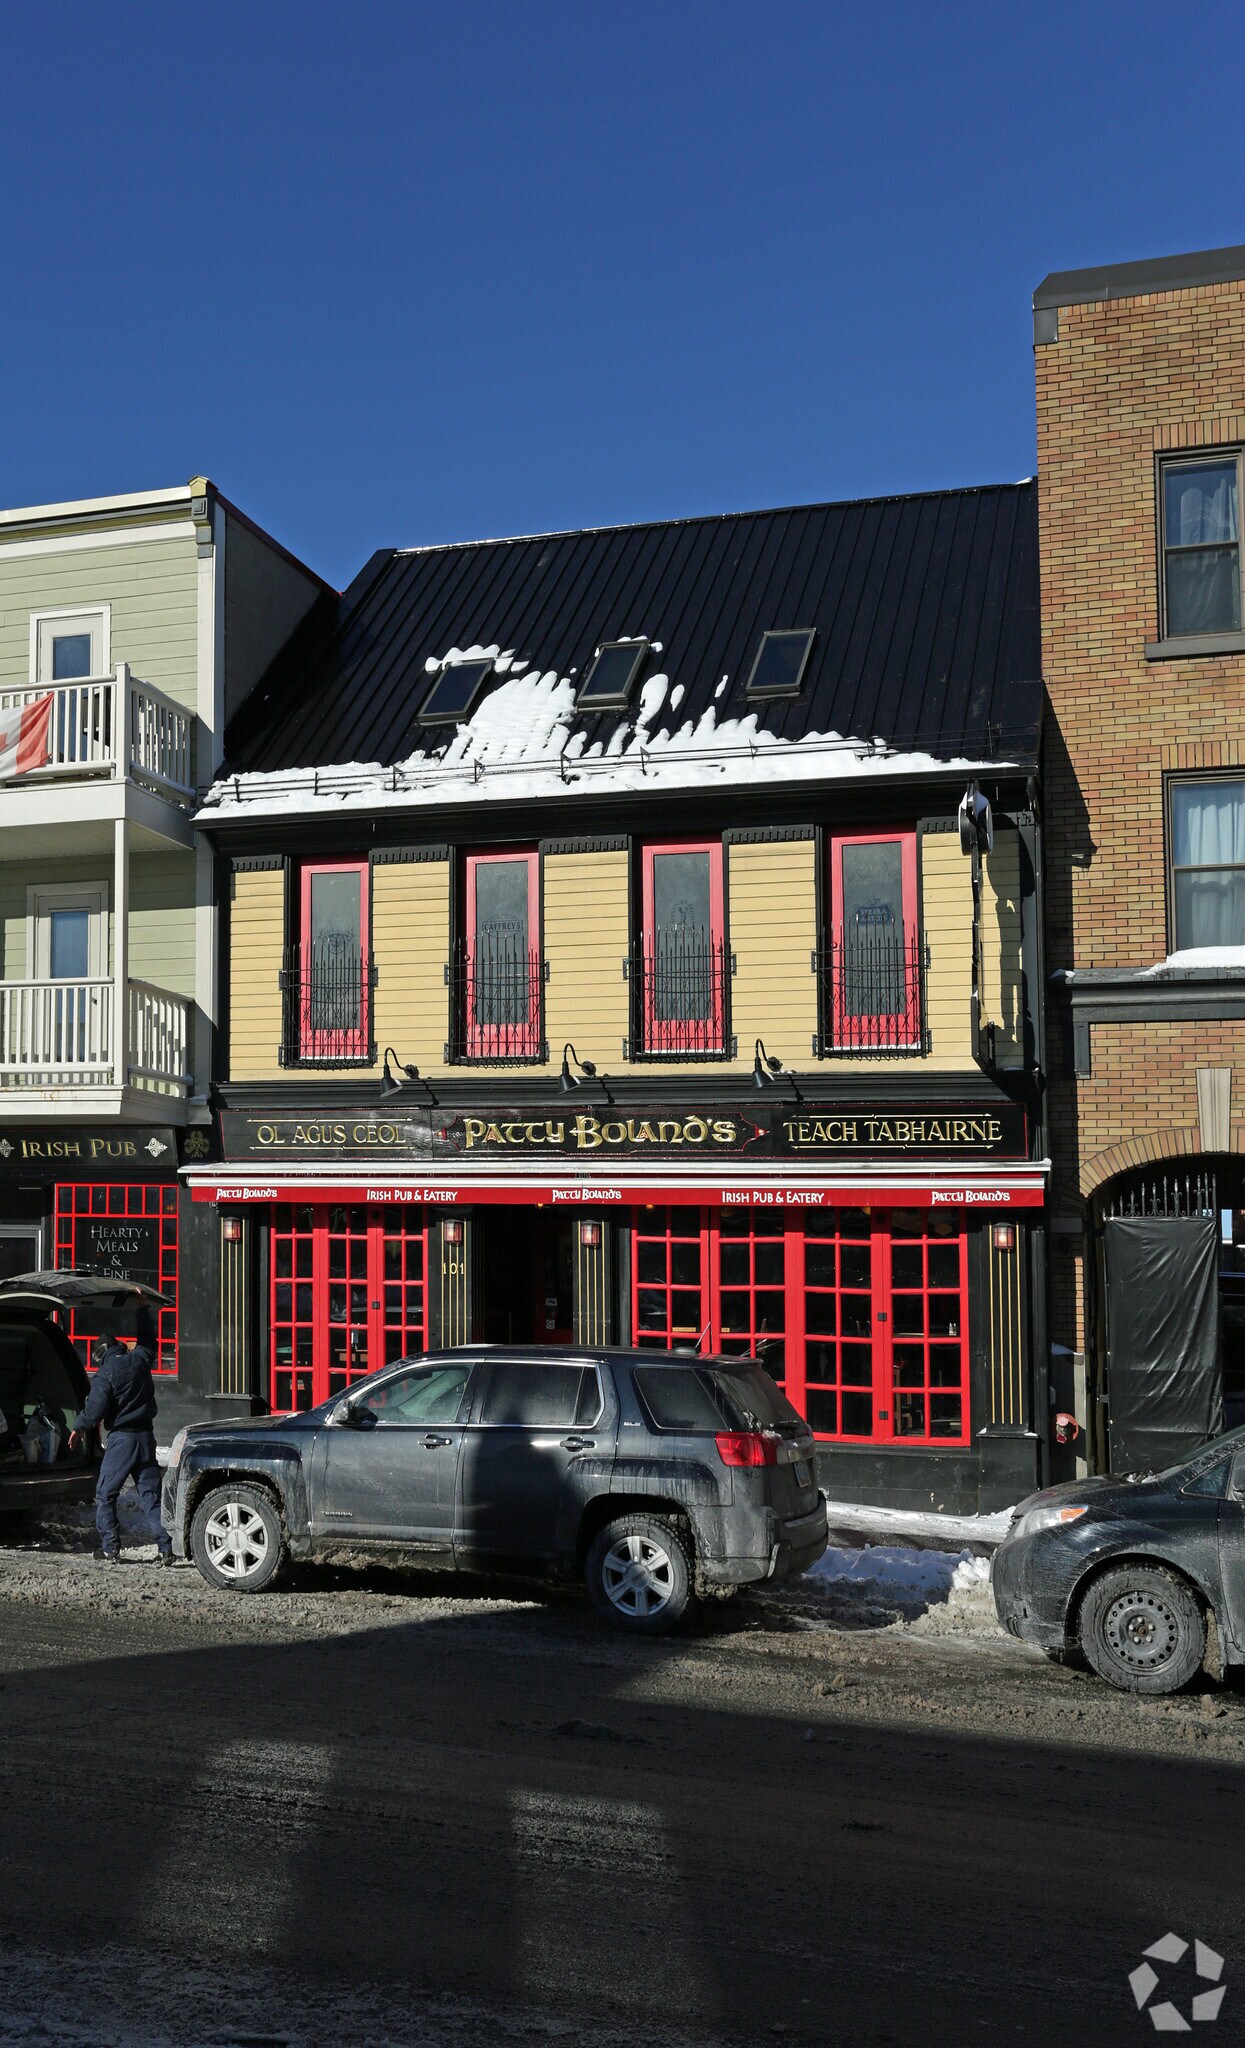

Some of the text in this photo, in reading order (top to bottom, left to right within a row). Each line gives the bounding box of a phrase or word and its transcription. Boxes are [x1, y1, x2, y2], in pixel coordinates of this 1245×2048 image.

[256, 1124, 407, 1144] OL AGUS CEOL
[783, 1120, 1003, 1142] TEACH TABHAIRNE
[20, 1138, 137, 1158] IRISH PUB
[366, 1189, 458, 1201] IRISH PUB & EATERY
[721, 1190, 825, 1204] IRISH PUB & EATERY
[91, 1225, 143, 1239] HEARTY
[96, 1240, 139, 1253] MEALS
[111, 1254, 122, 1267] &
[442, 1262, 465, 1275] 101
